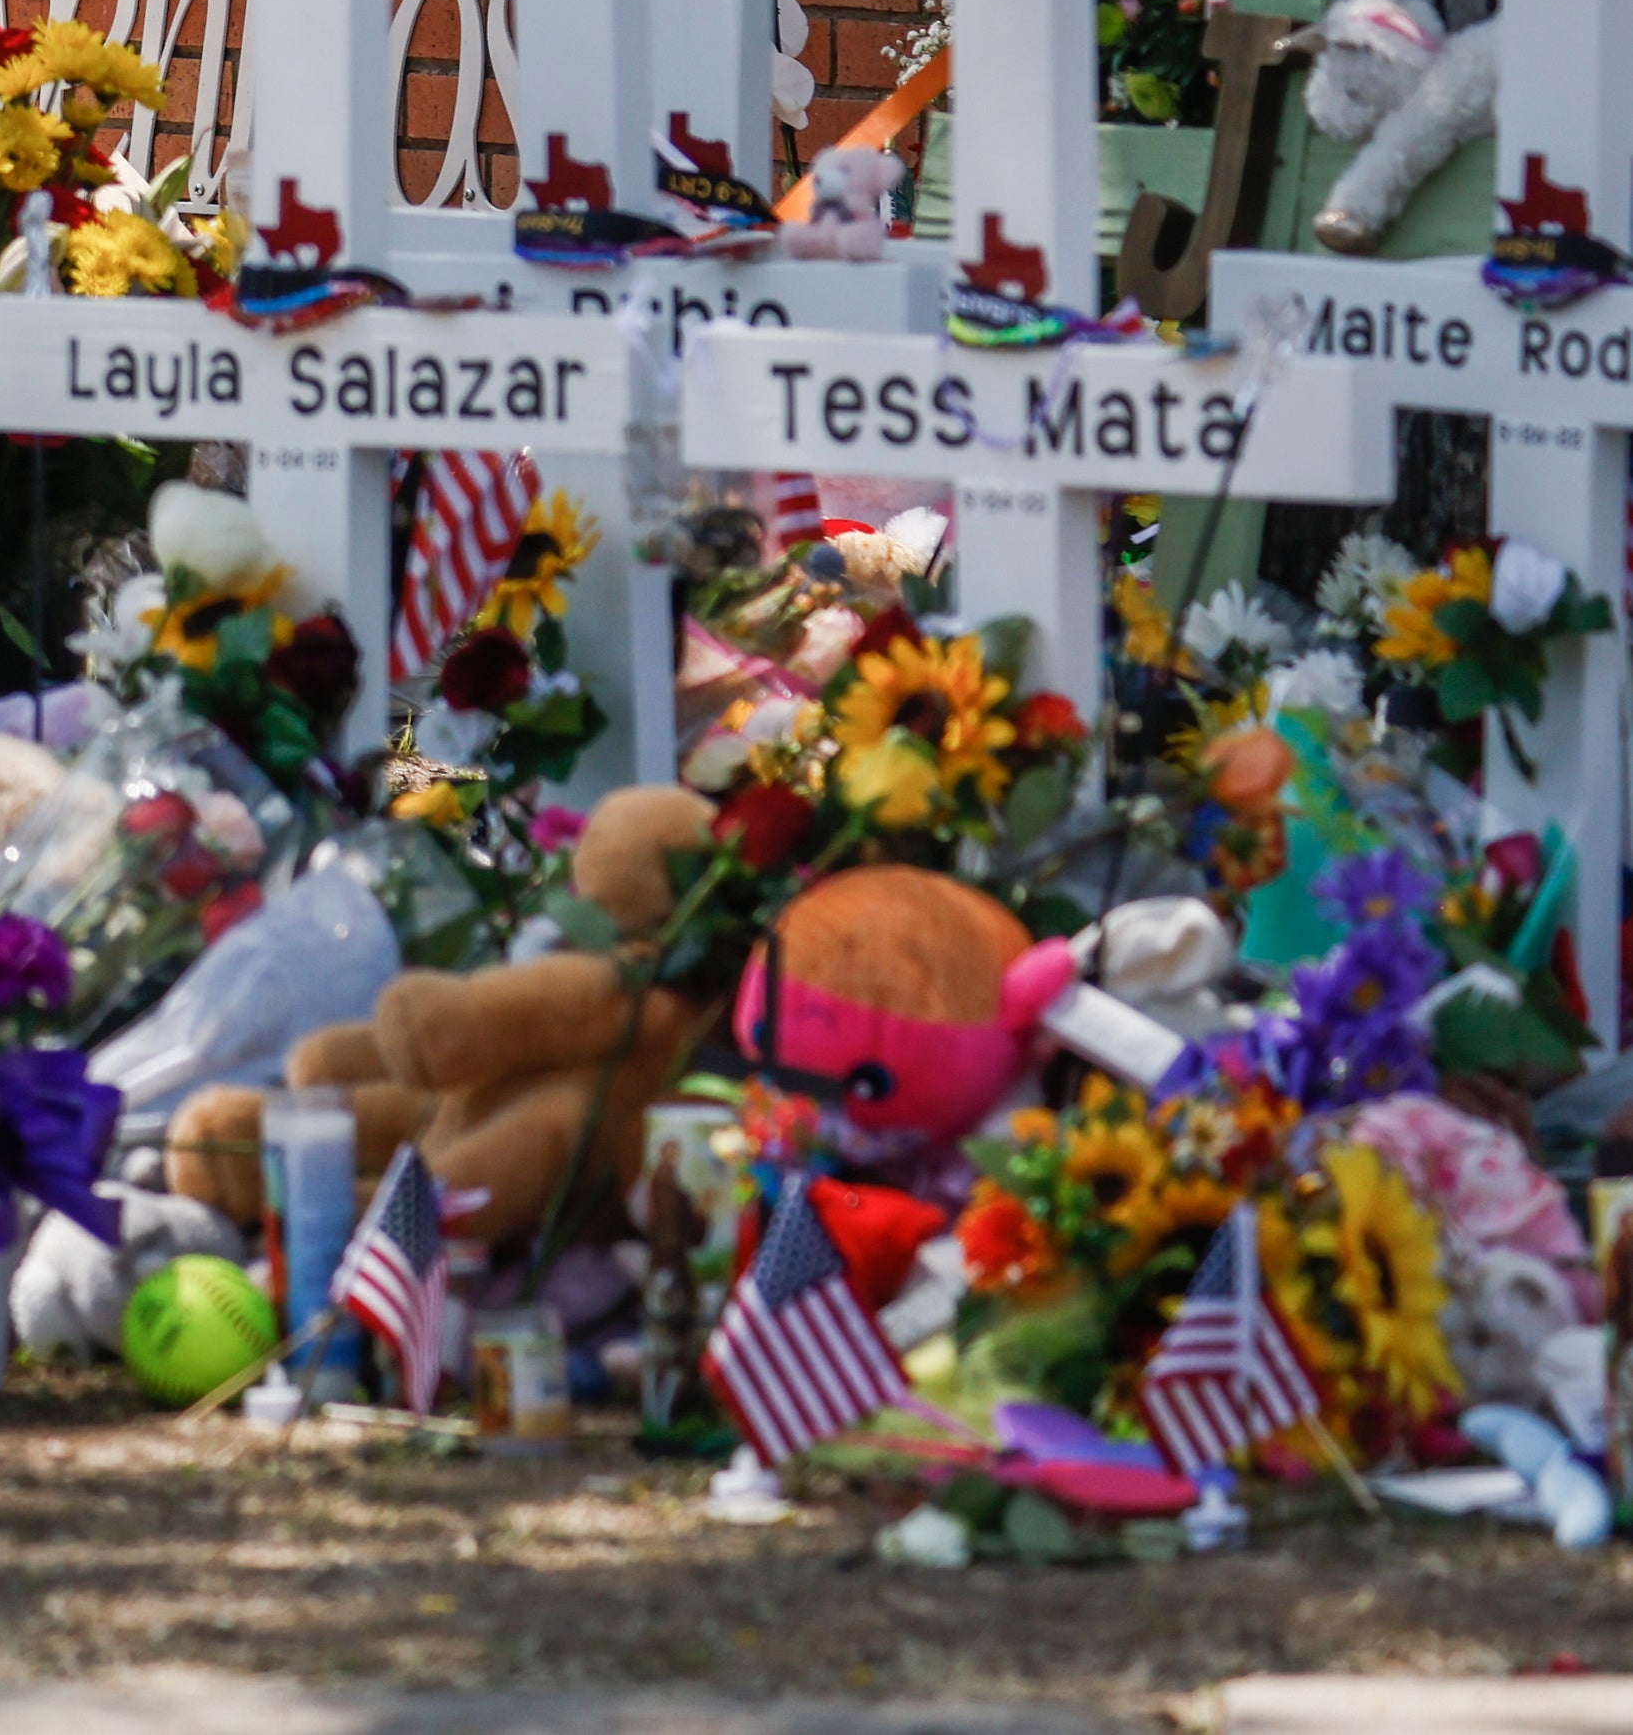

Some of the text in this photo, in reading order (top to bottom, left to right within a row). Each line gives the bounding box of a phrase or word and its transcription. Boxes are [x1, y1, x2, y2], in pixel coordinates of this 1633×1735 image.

[68, 338, 587, 422] Layla Salazar
[769, 361, 1245, 461] Tess Mata
